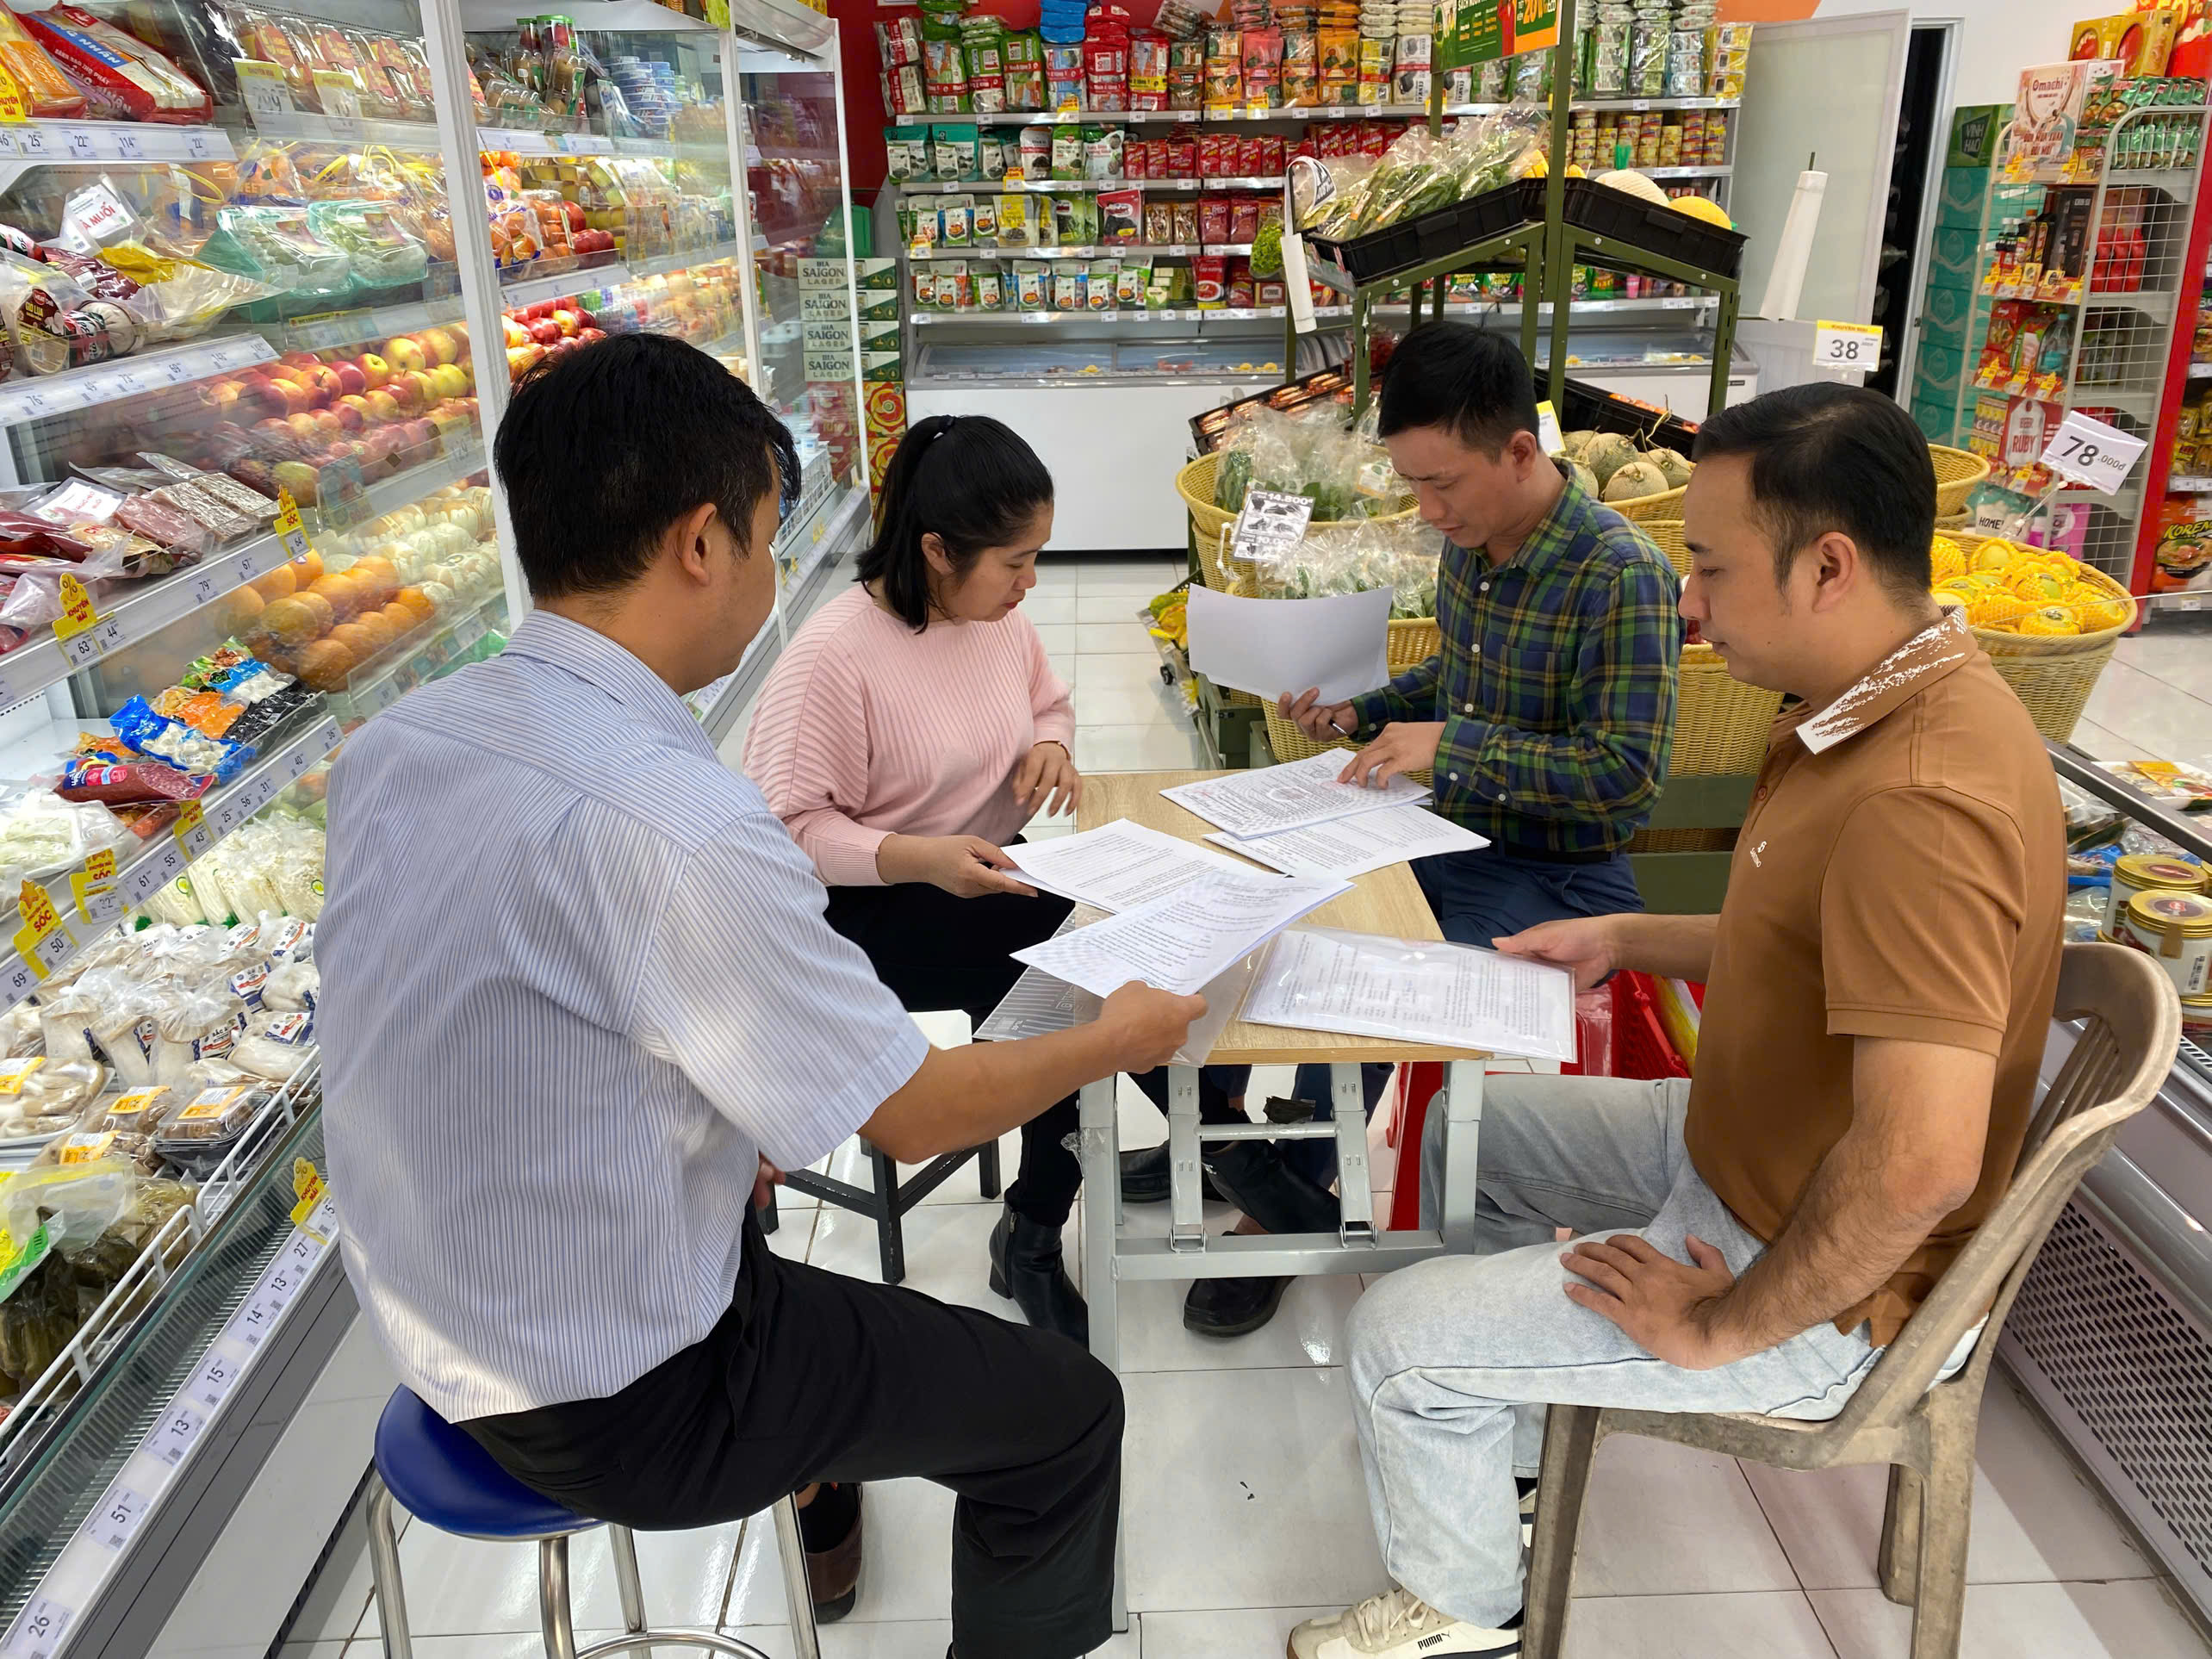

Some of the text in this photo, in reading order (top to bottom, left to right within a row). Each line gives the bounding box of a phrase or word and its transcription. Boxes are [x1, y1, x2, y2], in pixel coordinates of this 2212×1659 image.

[2033, 78, 2063, 91] Omachi
[28, 134, 41, 147] 25
[74, 135, 88, 147] 22
[803, 268, 844, 277] SAIGON
[805, 300, 847, 309] SAIGON
[807, 331, 848, 340] SAIGON
[1830, 339, 1859, 359] 38
[808, 361, 850, 370] SAIGON
[2012, 435, 2036, 454] RUBY
[2061, 435, 2099, 467] 78
[241, 558, 252, 570] 67
[198, 581, 210, 593] 79
[107, 627, 118, 639] 44
[78, 640, 90, 655] 63
[294, 754, 304, 766] 40
[259, 780, 270, 793] 31
[240, 795, 252, 808] 56
[221, 811, 232, 823] 25
[195, 831, 205, 843] 43
[164, 853, 177, 867] 55
[138, 873, 152, 888] 61
[33, 909, 53, 933] SỐC
[50, 936, 65, 954] 50
[11, 971, 27, 988] 69
[293, 1241, 310, 1258] 27
[270, 1277, 288, 1293] 13
[246, 1308, 264, 1326] 14
[206, 1366, 226, 1384] 15
[171, 1418, 190, 1438] 13
[110, 1503, 133, 1525] 51
[28, 1614, 51, 1638] 26
[1417, 1633, 1444, 1651] PUMA
